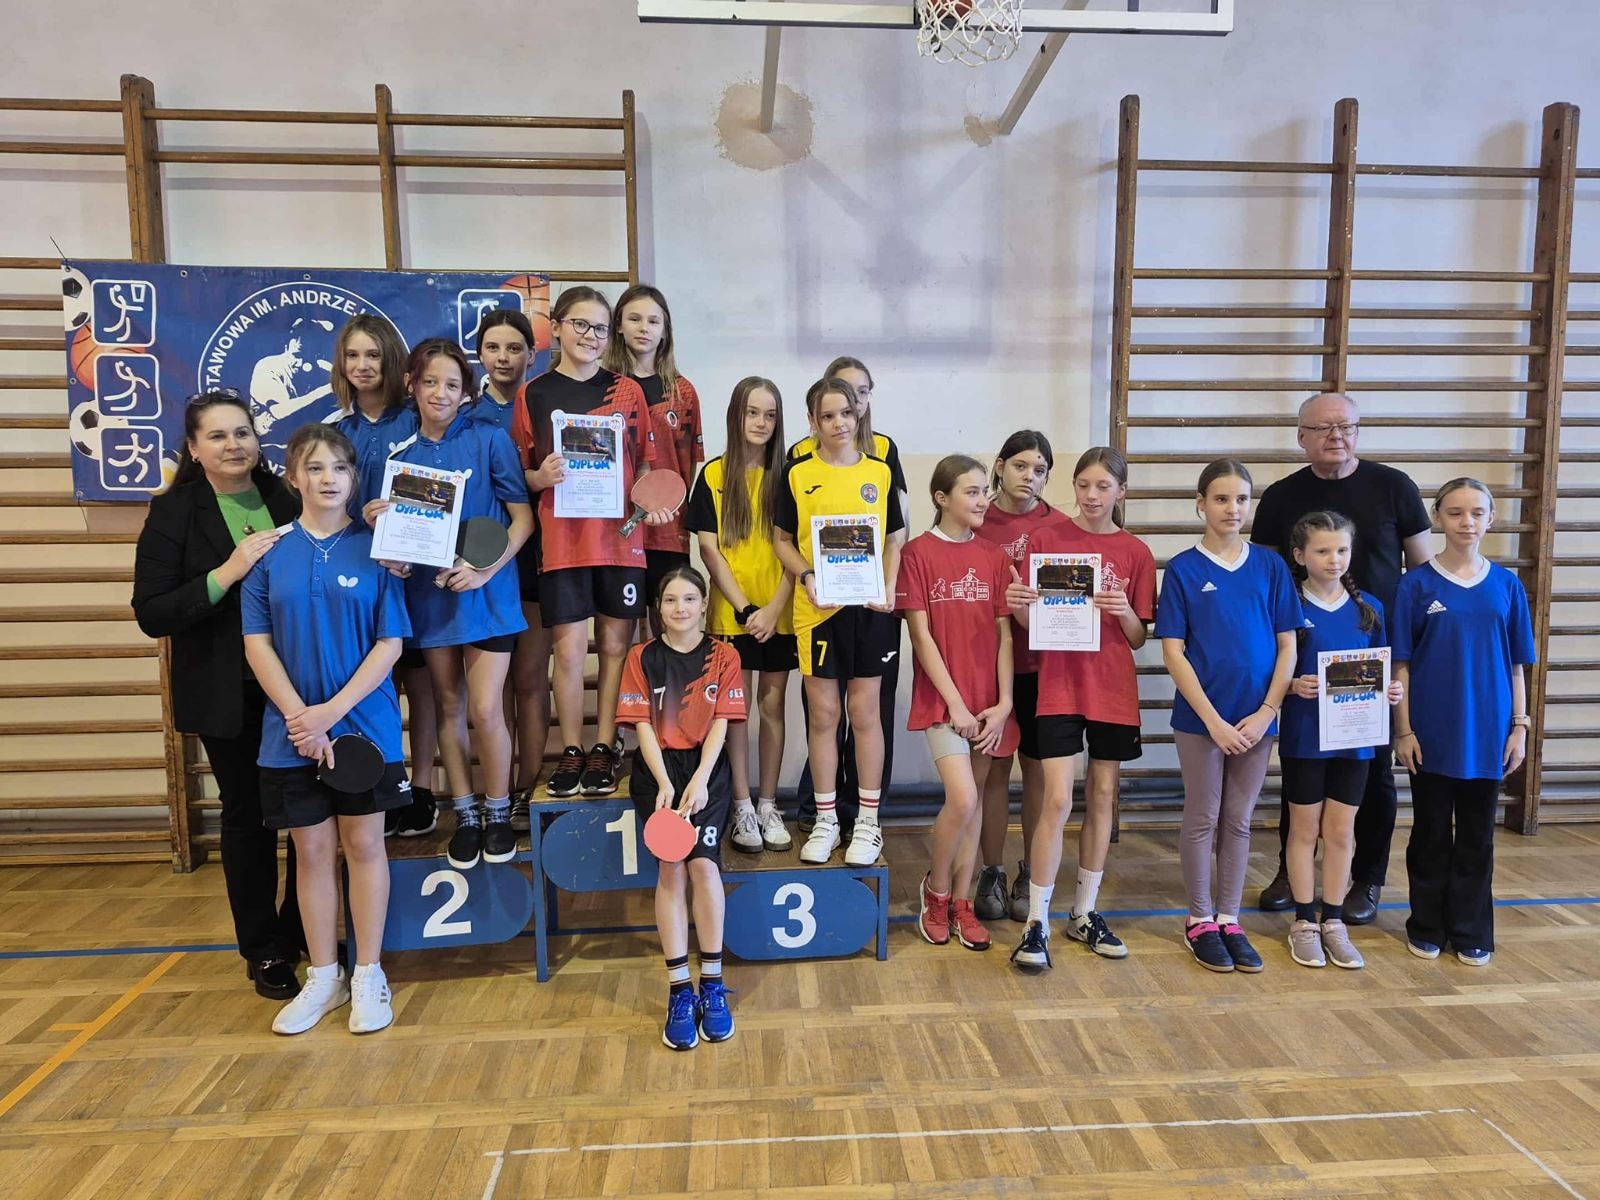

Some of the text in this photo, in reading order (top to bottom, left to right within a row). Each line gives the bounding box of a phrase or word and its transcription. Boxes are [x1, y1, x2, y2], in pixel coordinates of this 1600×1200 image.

[250, 298, 278, 319] IM.
[569, 458, 611, 470] DYPLOM
[395, 503, 445, 520] DYPLOM
[827, 554, 870, 564] DYPLOM
[623, 583, 637, 606] 9
[1043, 595, 1087, 605] DYPLOM
[816, 640, 828, 666] 7
[653, 686, 666, 711] 7
[1333, 690, 1377, 704] DYPLOM
[605, 809, 638, 875] 1
[702, 825, 718, 847] 8
[420, 869, 472, 938] 2
[772, 882, 817, 949] 3
